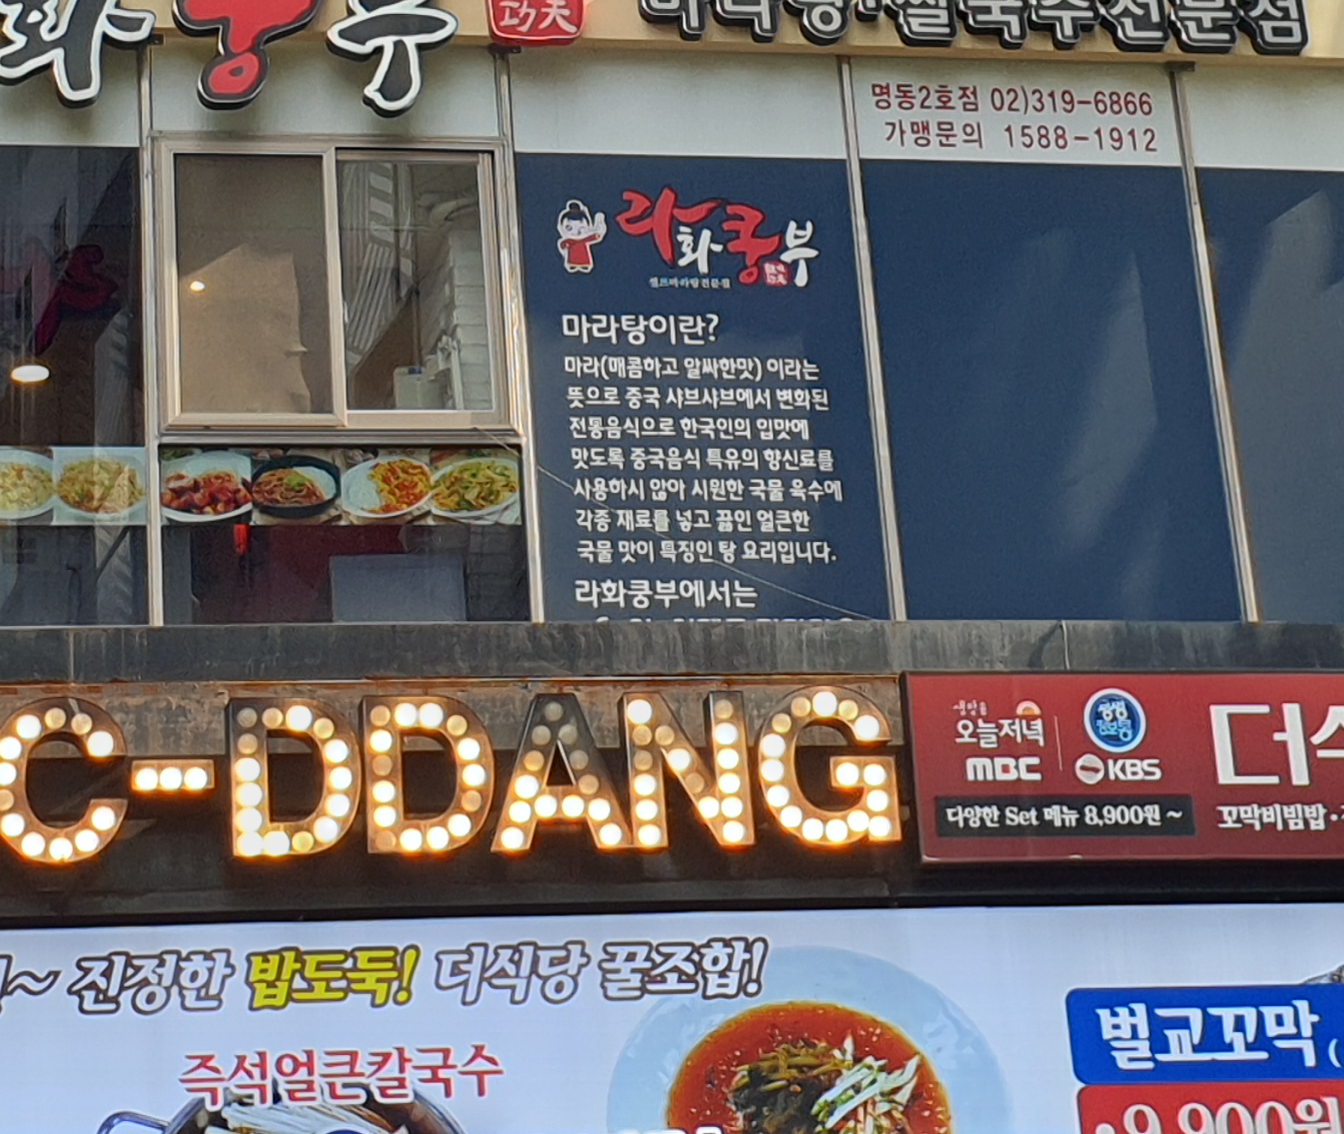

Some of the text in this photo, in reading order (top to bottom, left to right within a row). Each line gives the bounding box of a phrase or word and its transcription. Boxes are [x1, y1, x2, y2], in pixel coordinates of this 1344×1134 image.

[871, 82, 1154, 117] 명동2호점 02)319-6866
[884, 119, 1158, 154] 가맹문의 1588-1912
[561, 314, 720, 344] 마라탕이란?
[767, 359, 820, 380] 이라는
[566, 387, 829, 410] 뜻으로 중국 샤브샤브에서 변화된
[569, 417, 810, 440] 전통음식으로 한국인의 입맛에
[630, 448, 700, 470] 중국음식
[705, 449, 758, 470] 특유의
[763, 449, 833, 471] 향신료를
[691, 479, 744, 501] 시원한
[749, 479, 785, 501] 국물
[789, 480, 843, 502] 육수에
[576, 509, 810, 532] 각종 재료를 넣고 끓인 얼큰한
[577, 541, 837, 564] 국물 맛이 특징인 탕 요리입니다.
[575, 579, 758, 609] 라화쿵부에서는
[955, 718, 1044, 748] 오늘저녁
[966, 757, 1042, 781] MBC
[1108, 759, 1162, 781] KBS
[945, 803, 1162, 829] 다양한 Set 메뉴 8,900원
[68, 948, 236, 1017] 진정한
[247, 944, 420, 1012] 밥도둑!
[434, 940, 592, 1006] 더식당
[597, 936, 769, 1002] 꿀조합!
[1095, 999, 1320, 1071] 벌교꼬막
[177, 1043, 505, 1106] 즉석얼큰칼국수
